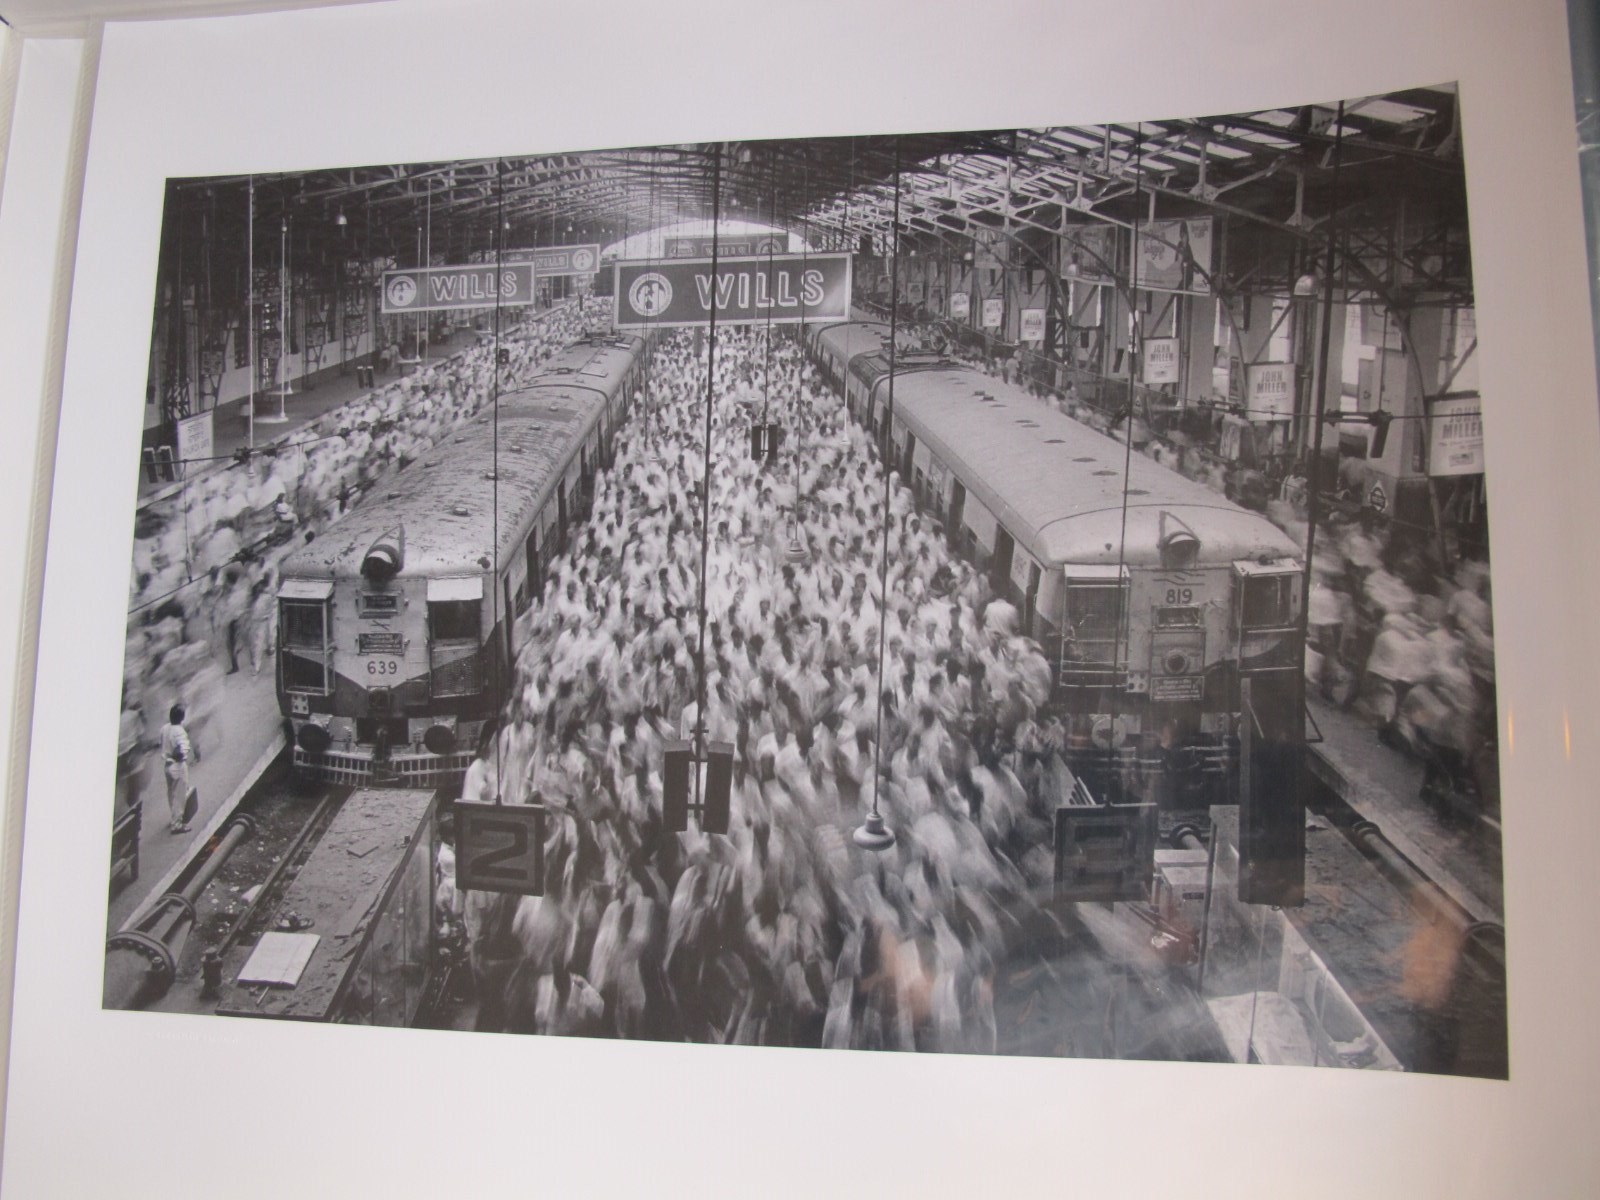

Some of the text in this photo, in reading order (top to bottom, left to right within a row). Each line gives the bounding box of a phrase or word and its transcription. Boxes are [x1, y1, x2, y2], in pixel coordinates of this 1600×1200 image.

[431, 271, 517, 301] WILLS
[694, 269, 825, 310] WILLS
[1261, 370, 1283, 382] JOHN
[1256, 381, 1287, 394] MILLER
[1165, 588, 1194, 605] 819
[366, 660, 398, 675] 639
[470, 819, 529, 880] 2
